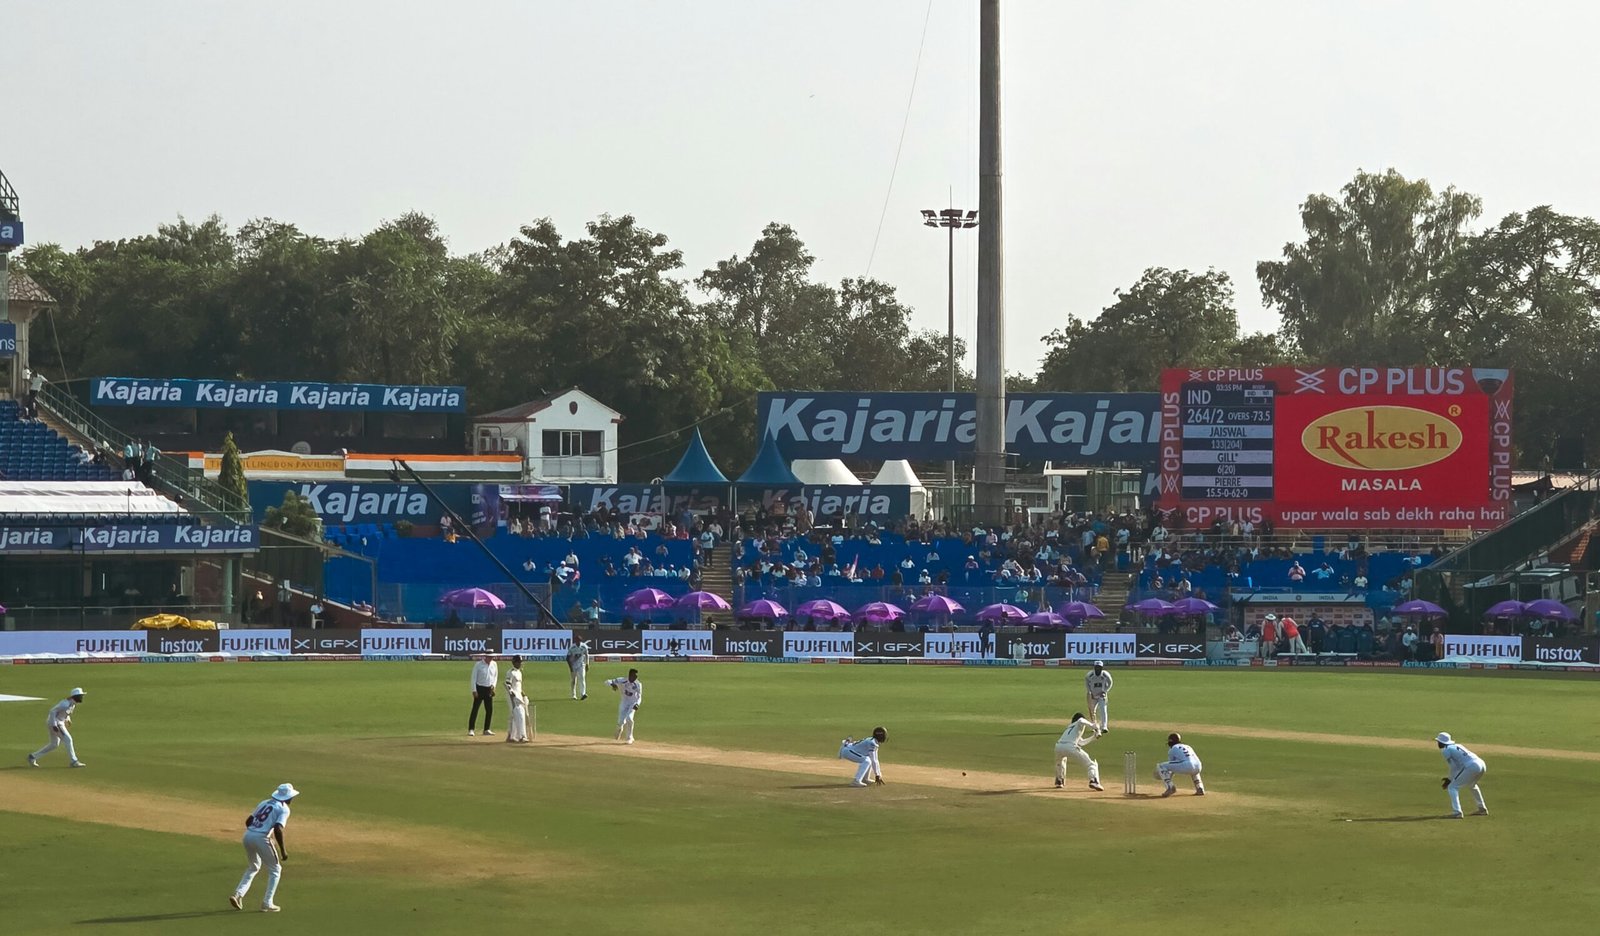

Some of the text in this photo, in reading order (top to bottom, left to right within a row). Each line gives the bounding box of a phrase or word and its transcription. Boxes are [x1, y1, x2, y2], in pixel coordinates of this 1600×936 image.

[1208, 368, 1263, 381] CP PLUS
[1339, 368, 1465, 394] CP PLUS
[97, 381, 460, 411] Kajaria Kajaria Kajaria Kajaria
[1187, 390, 1211, 405] IND
[1187, 408, 1224, 424] 264/2
[1228, 412, 1250, 421] OVERS
[764, 398, 976, 453] Kajaria
[1163, 392, 1180, 471] CP PLUS
[1209, 427, 1247, 437] JAISWAL
[1316, 411, 1449, 468] Rakesh
[1493, 422, 1509, 501] CP PLUS
[1217, 465, 1236, 475] 6(20)
[1215, 477, 1241, 487] PIERRE
[1341, 478, 1422, 491] MASALA
[300, 484, 428, 522] Kajaria
[1186, 506, 1211, 523] CP
[1281, 507, 1505, 524] upar wala sab dekh raha hai
[80, 525, 159, 547] Kajaria
[174, 525, 252, 547] Kajaria
[76, 639, 146, 652] FUJIFILM
[160, 637, 203, 652] instax
[221, 638, 289, 650] FUJIFILM
[320, 639, 359, 649] GFX
[362, 637, 430, 650] FUJIFILM
[444, 636, 486, 651] instax
[504, 637, 571, 650] FUJIFILM
[601, 640, 639, 649] GFX
[644, 639, 712, 651] FUJFILM
[725, 637, 767, 653] instax
[785, 639, 853, 652] FUJIFILM
[883, 642, 922, 652] GFX
[1008, 640, 1050, 655] istax
[1067, 641, 1134, 654] FUJIFILM
[1165, 643, 1203, 653] GFX
[1446, 643, 1519, 657] FUJIFILM
[1535, 643, 1582, 661] instax
